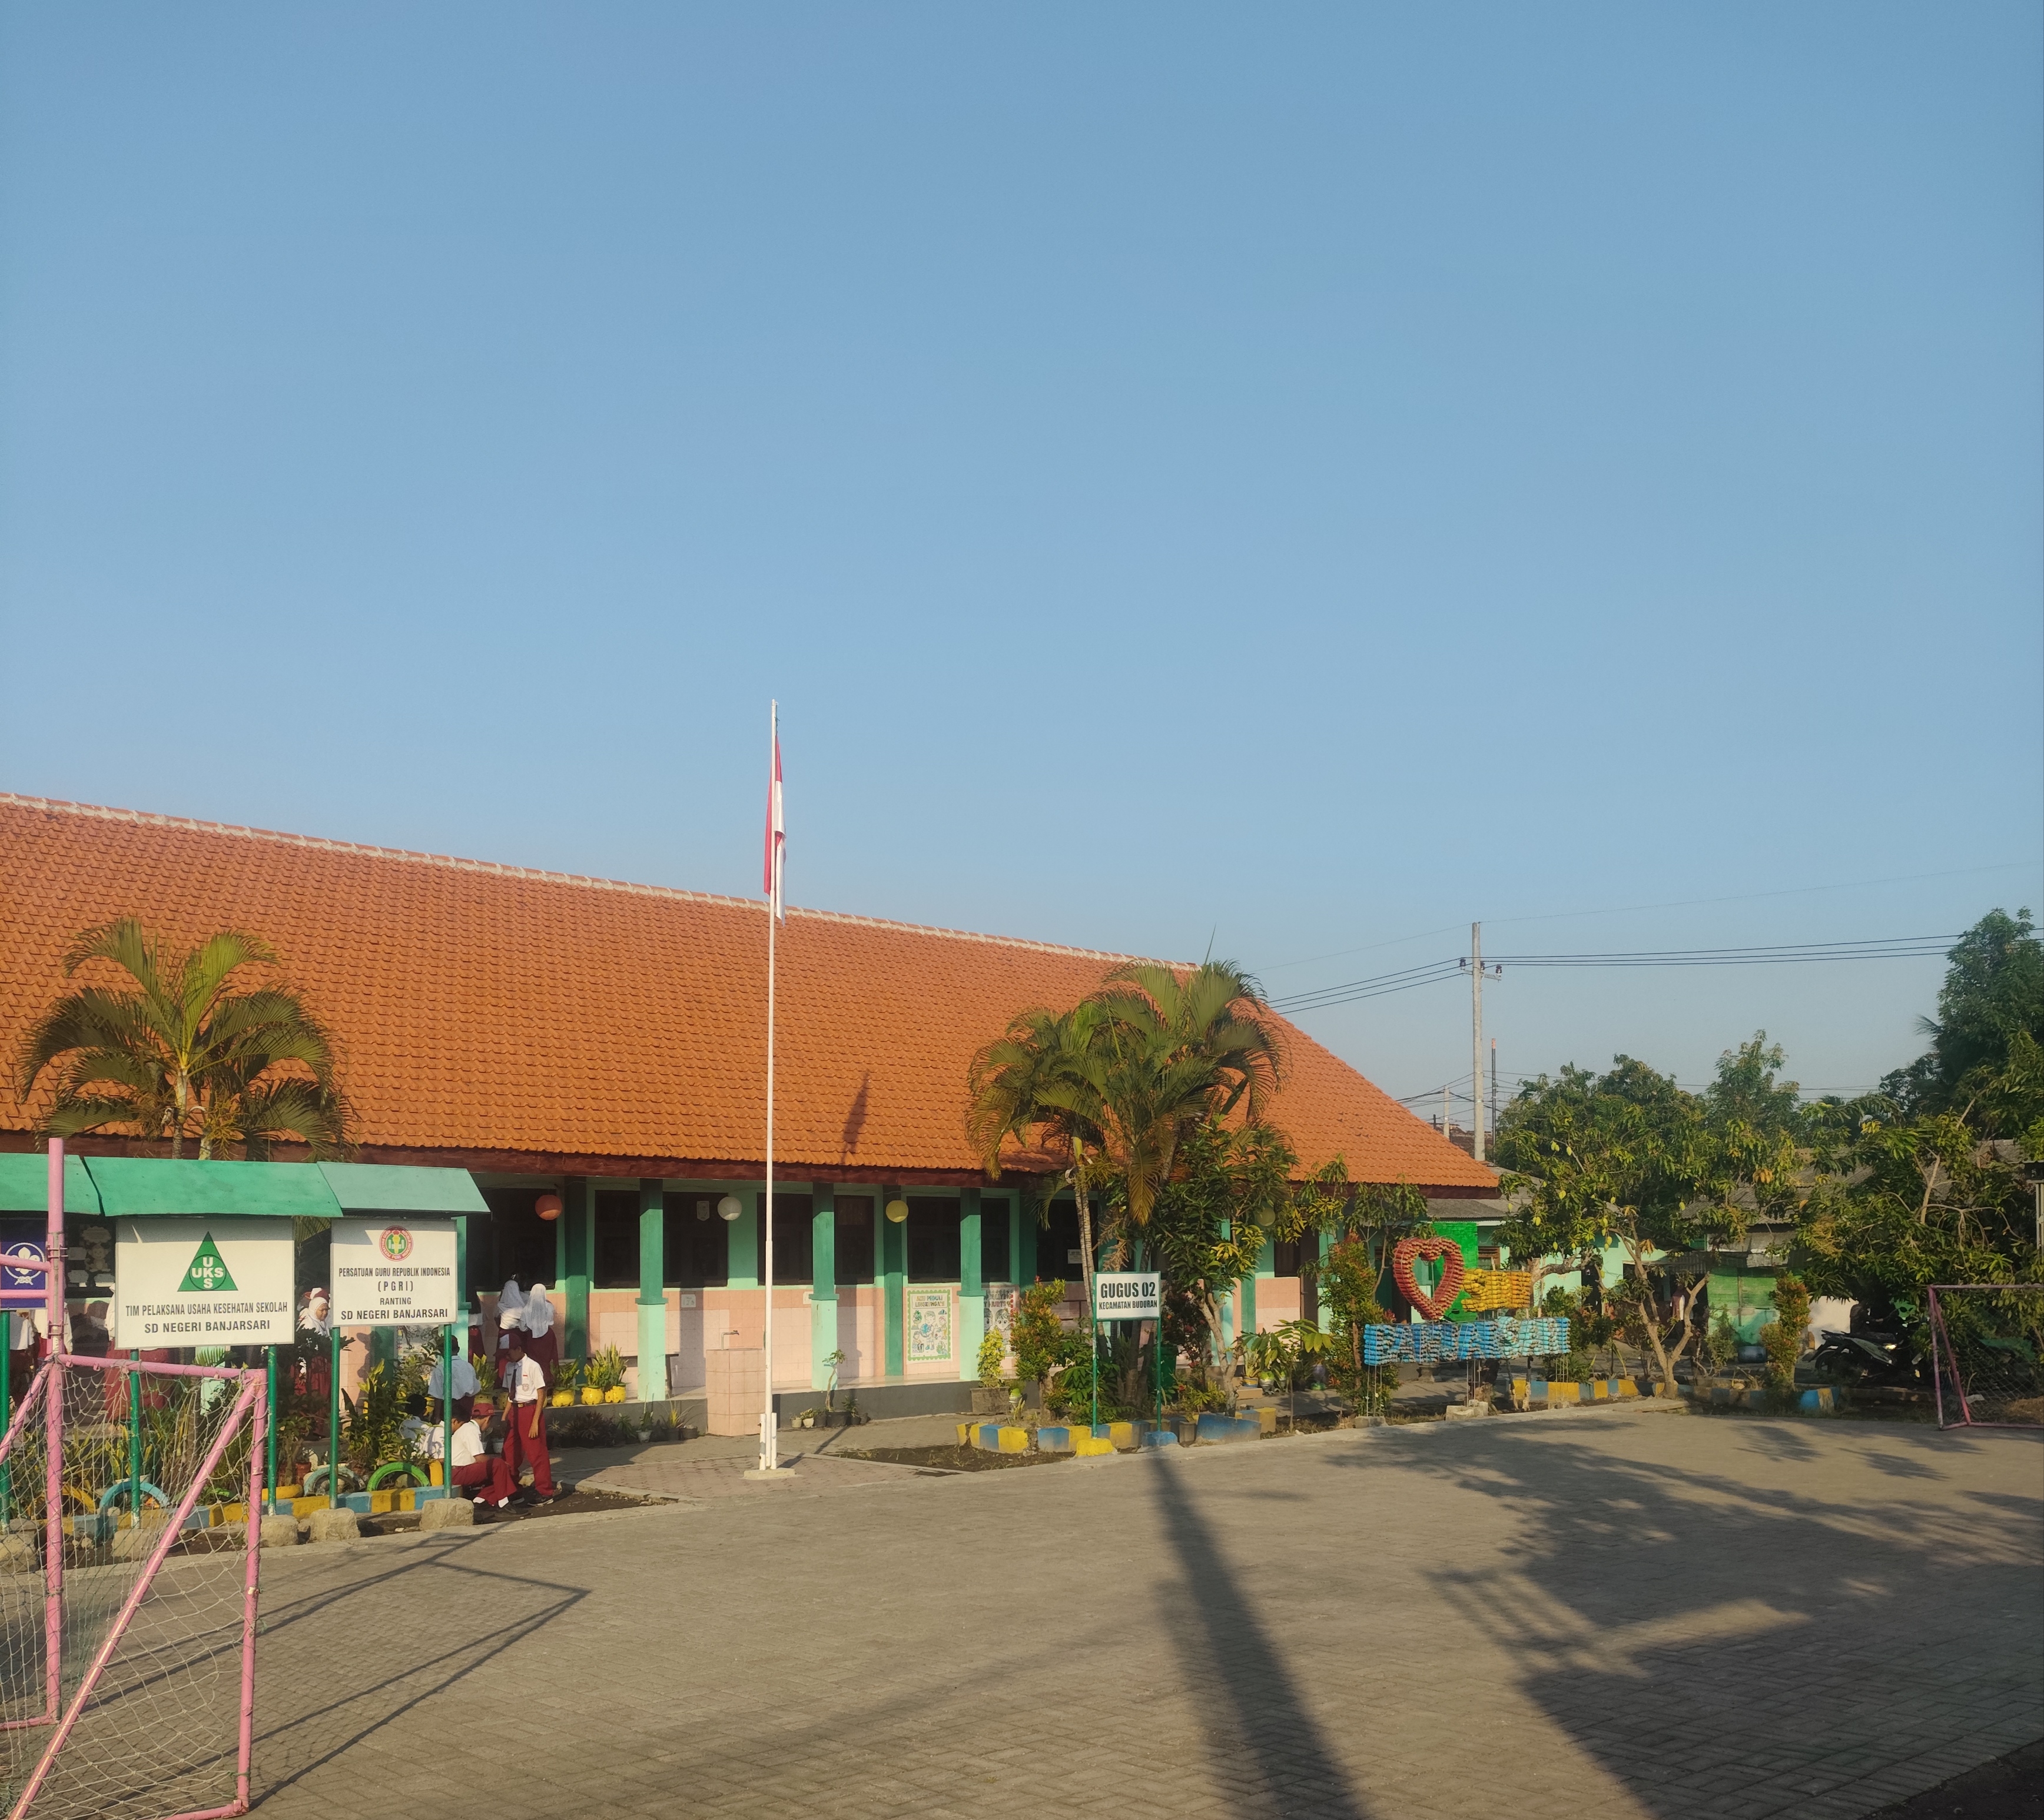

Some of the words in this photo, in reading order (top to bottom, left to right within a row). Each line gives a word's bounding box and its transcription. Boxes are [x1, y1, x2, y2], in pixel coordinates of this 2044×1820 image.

[191, 1267, 224, 1278] UKS
[339, 1268, 373, 1277] PERSATUAN
[375, 1267, 391, 1277] GURU
[392, 1267, 419, 1276] REPUBLIK
[421, 1267, 450, 1276] INDONESIA
[1100, 1282, 1139, 1298] GUGUS
[1142, 1282, 1156, 1297] 02
[125, 1305, 140, 1316] TIM
[142, 1304, 185, 1316] PELAKSANA
[188, 1303, 211, 1314] USAHA
[214, 1302, 254, 1314] KESEHATAN
[256, 1301, 288, 1313] SEKOLAH
[1099, 1301, 1131, 1310] KECAMATAN
[1132, 1300, 1157, 1308] BUDURAN
[341, 1310, 353, 1320] SD
[357, 1310, 390, 1319] NEGERI
[393, 1308, 448, 1318] BANJARSARI
[144, 1323, 158, 1333] SD
[163, 1322, 201, 1333] NEGERI
[206, 1320, 270, 1331] BANJARSARI
